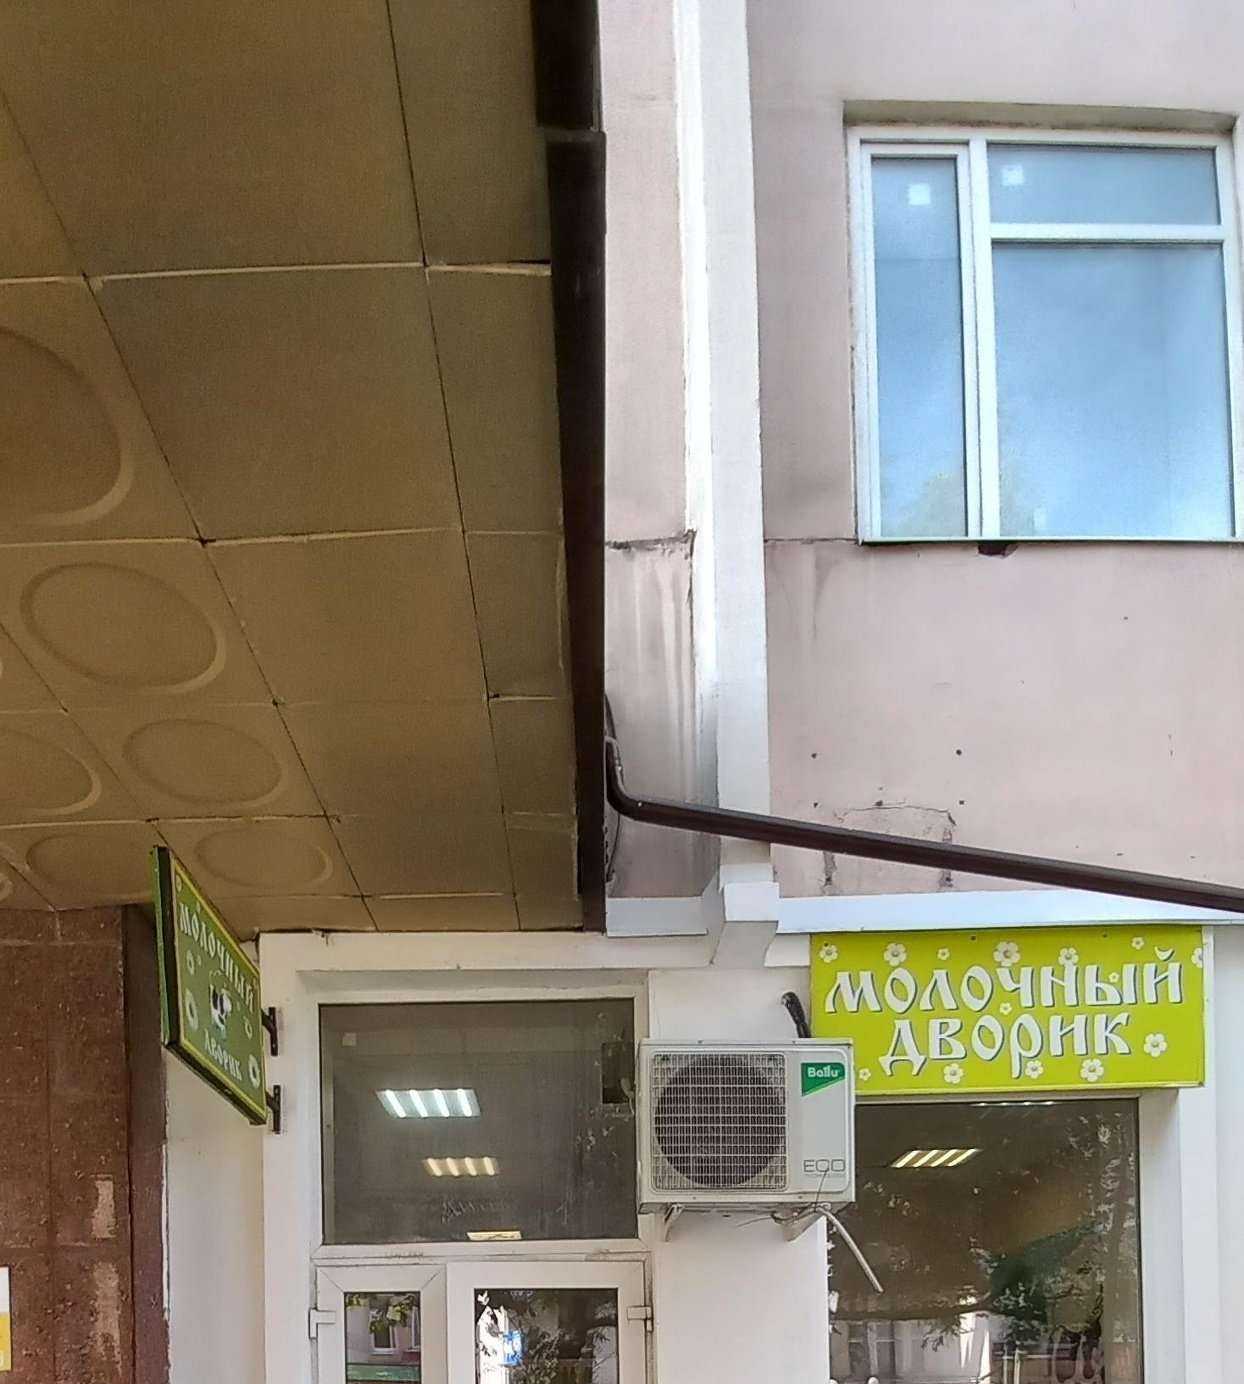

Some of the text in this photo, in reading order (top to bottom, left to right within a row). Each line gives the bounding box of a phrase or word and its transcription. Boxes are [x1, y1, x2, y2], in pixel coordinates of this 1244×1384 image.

[179, 902, 255, 1013] МОЛОЧНЫЙ
[825, 947, 1183, 1014] МОЛОЧНЫЙ
[807, 1065, 839, 1078] Ballu
[879, 1012, 1131, 1079] ДВОРИК
